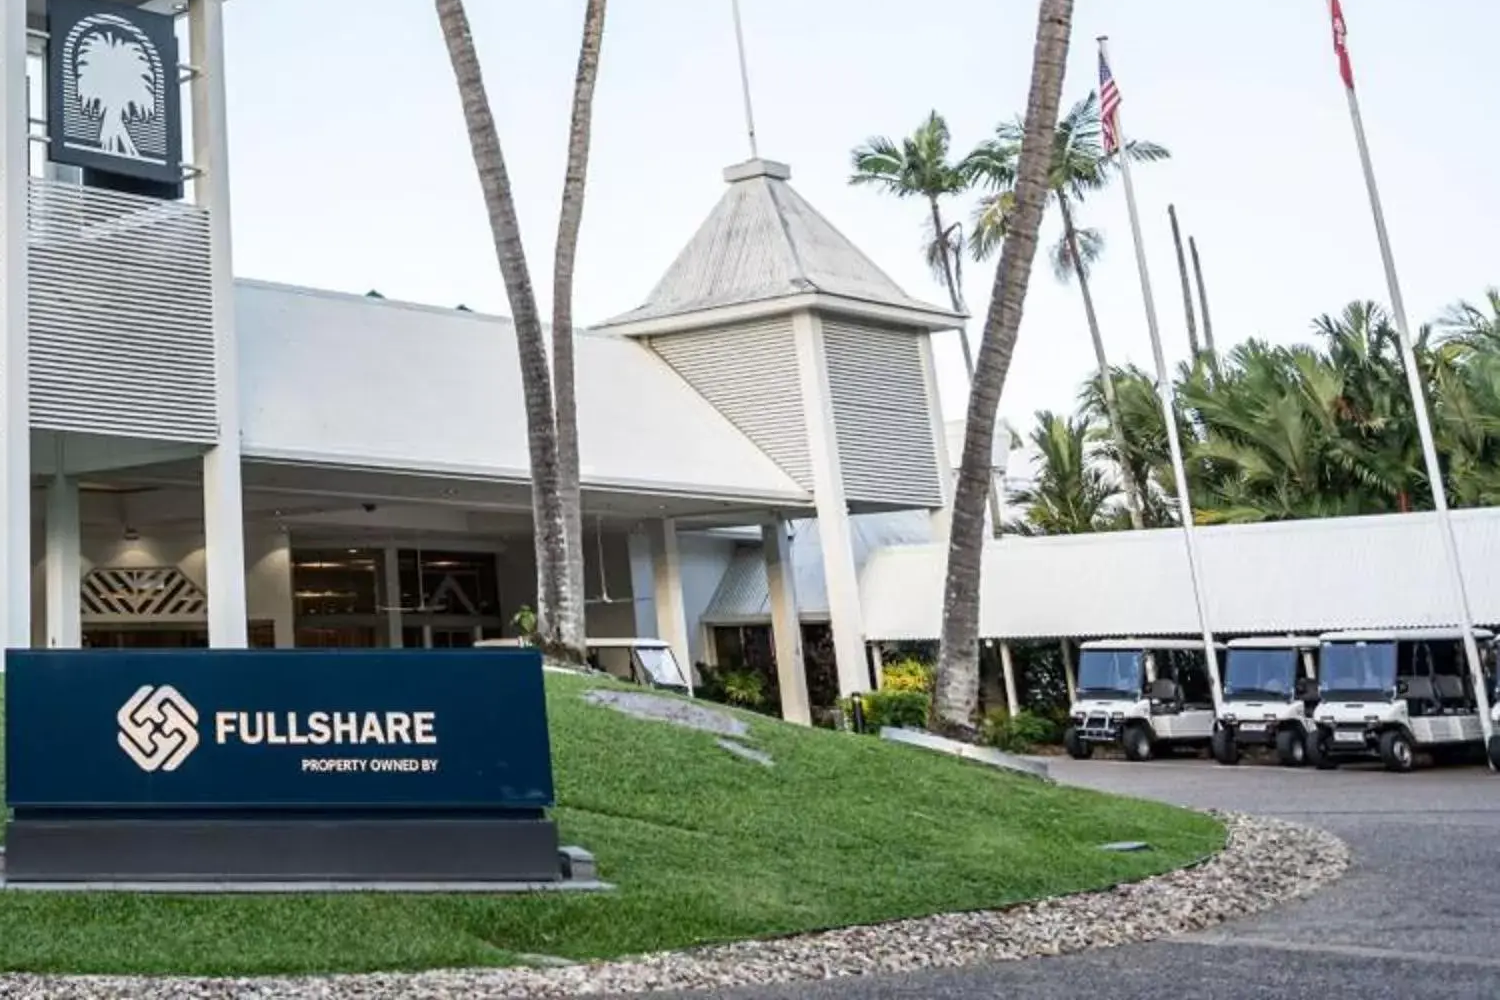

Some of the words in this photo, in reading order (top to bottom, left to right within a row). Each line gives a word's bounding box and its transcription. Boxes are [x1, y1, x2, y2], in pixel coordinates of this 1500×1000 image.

[215, 711, 437, 745] FULLSHARE
[301, 758, 367, 772] PROPERTY
[369, 758, 419, 772] OWNED
[421, 758, 438, 772] BY
